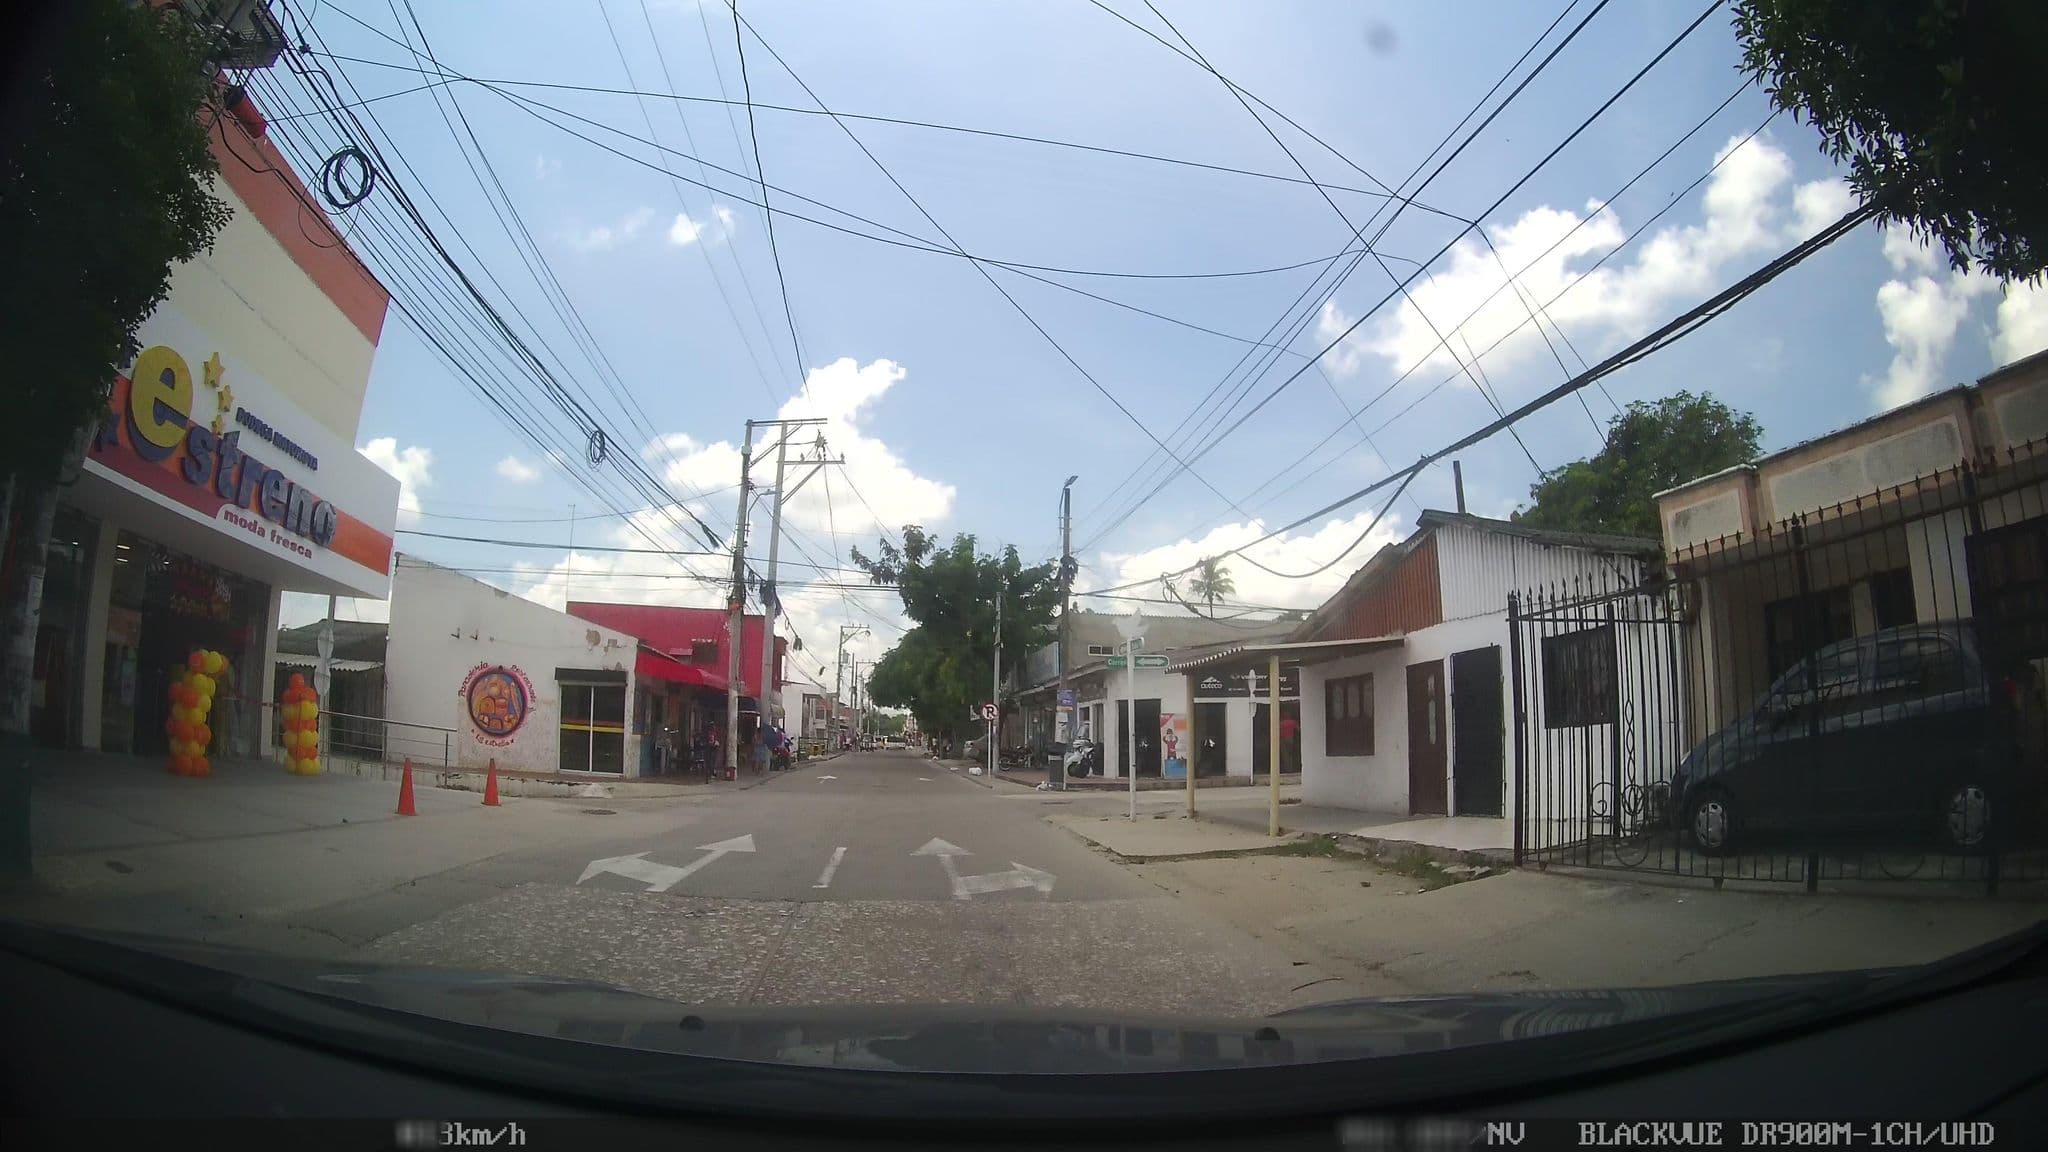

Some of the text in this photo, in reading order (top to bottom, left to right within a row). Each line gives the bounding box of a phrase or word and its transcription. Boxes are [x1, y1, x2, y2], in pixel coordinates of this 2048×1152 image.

[129, 345, 337, 548] estreno
[224, 510, 313, 559] moda fresca
